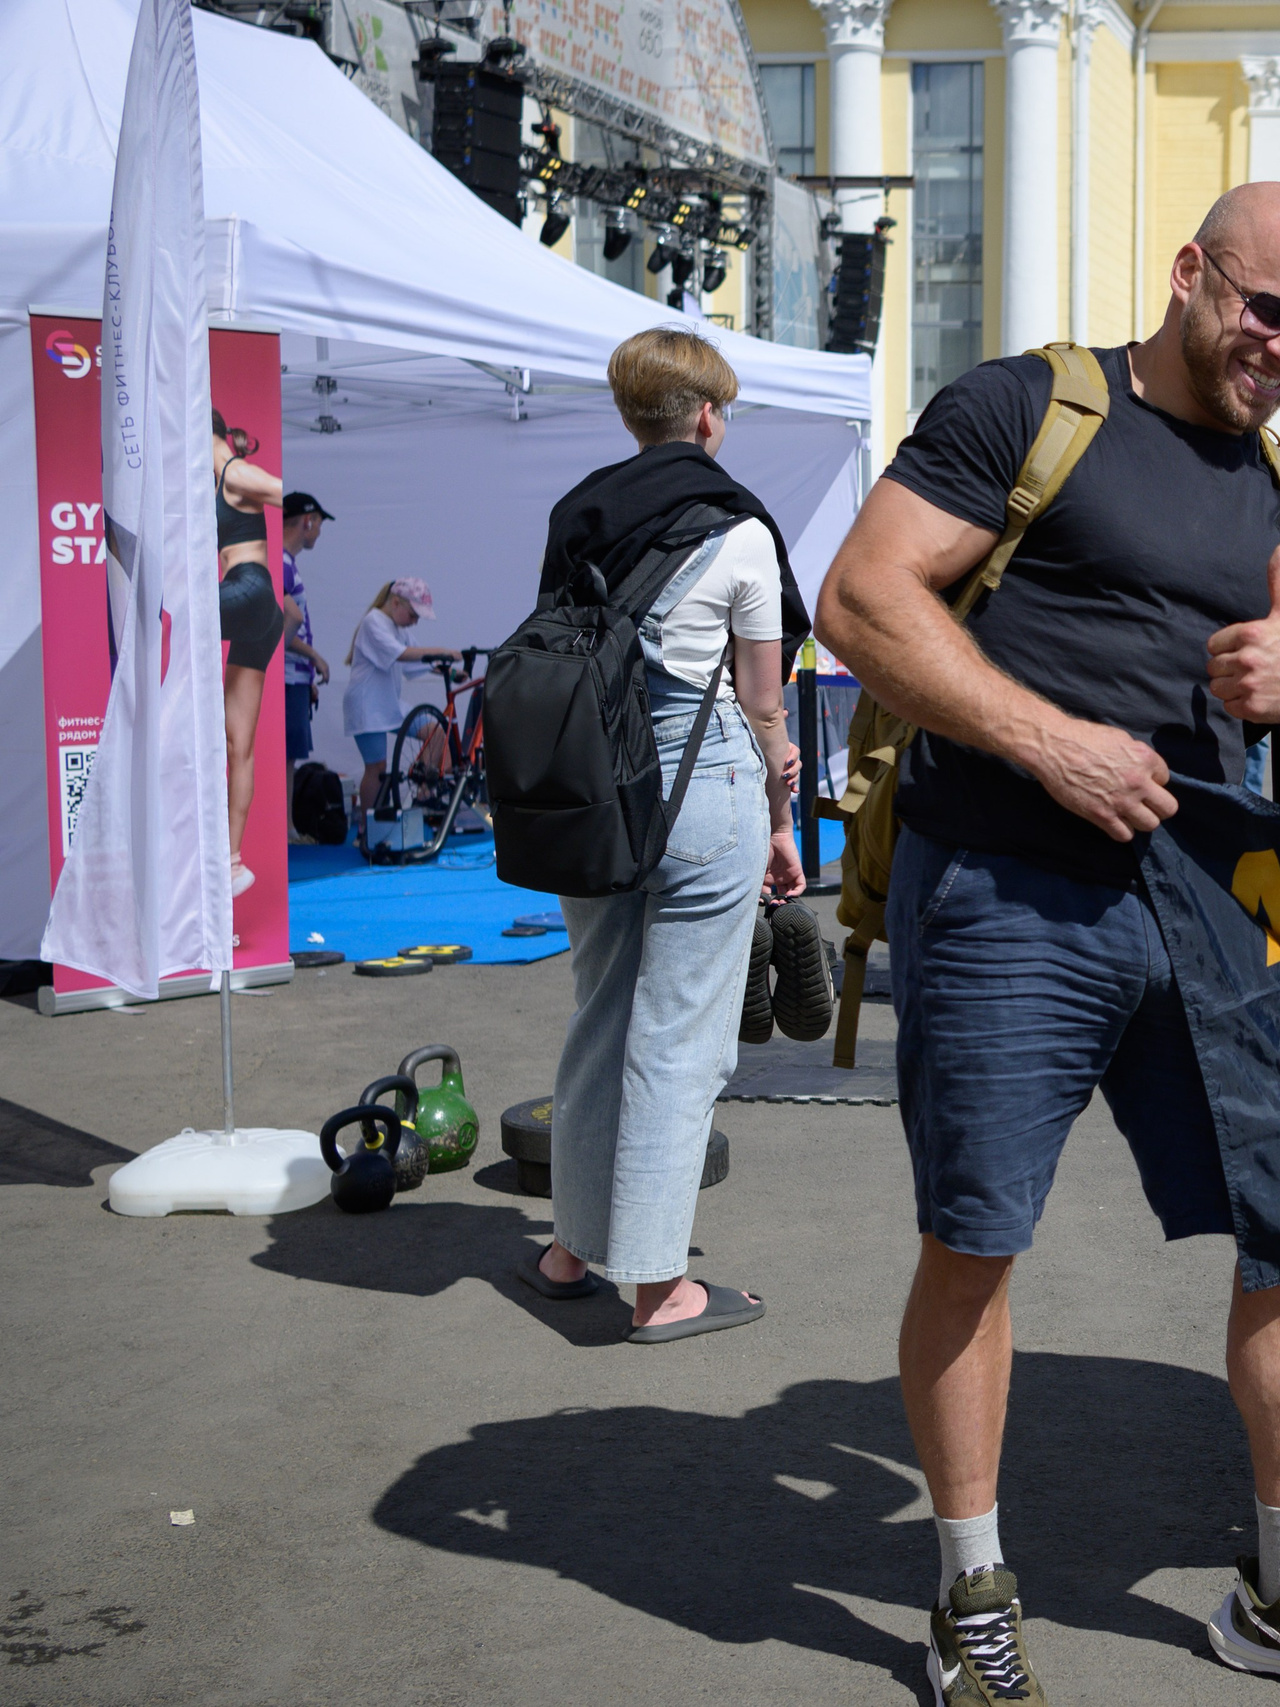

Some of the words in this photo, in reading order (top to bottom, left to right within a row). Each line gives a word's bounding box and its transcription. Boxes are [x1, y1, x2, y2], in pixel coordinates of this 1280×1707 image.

[121, 416, 142, 469] СЕТЬ
[51, 501, 106, 531] GY
[58, 729, 97, 743] рядом
